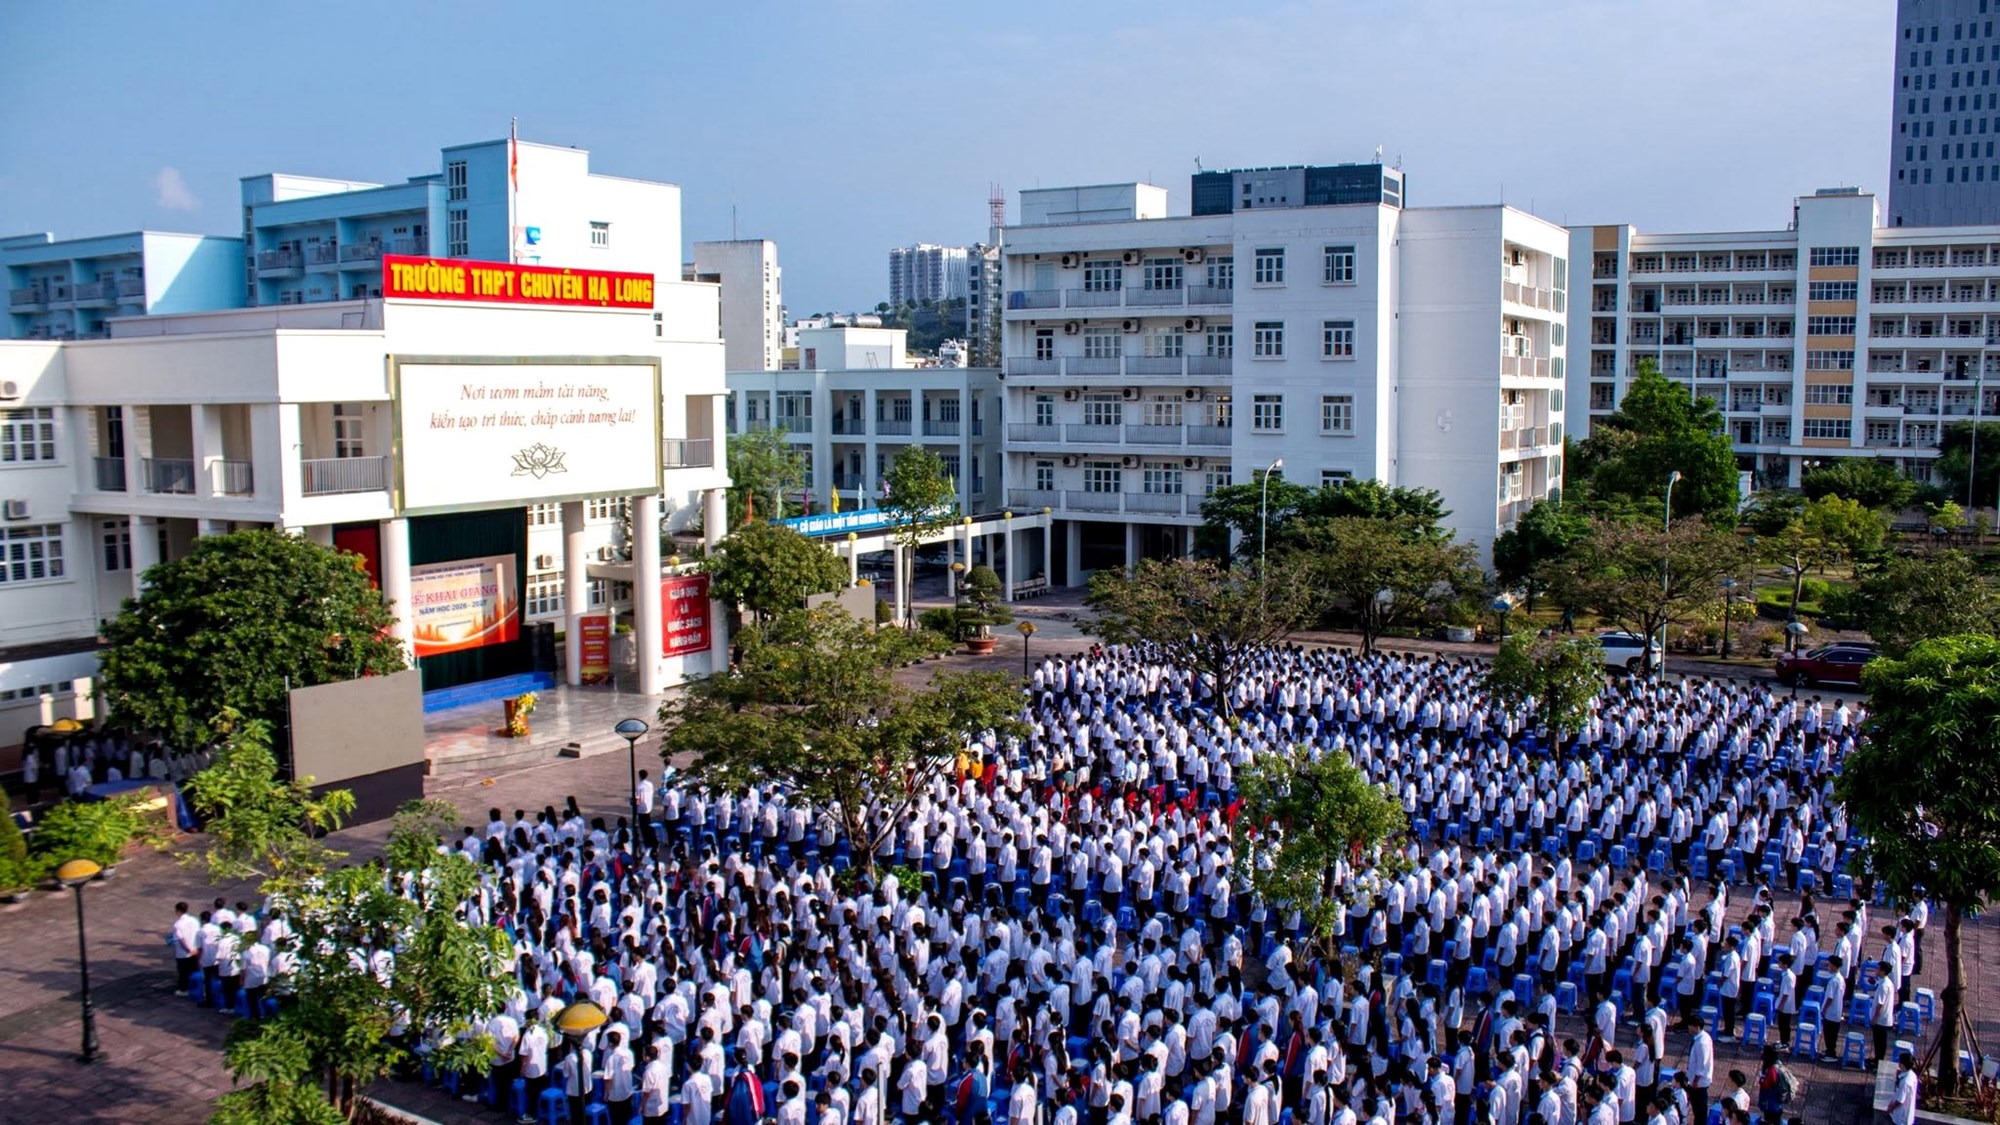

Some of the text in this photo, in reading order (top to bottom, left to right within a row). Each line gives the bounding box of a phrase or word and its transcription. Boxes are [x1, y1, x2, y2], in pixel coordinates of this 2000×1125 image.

[391, 261, 652, 306] TRƯỜNG THPT CHUYÊN HẠ LONG
[460, 381, 610, 402] Nơi ươm mầm tài năng,
[430, 409, 455, 429] kiến
[458, 415, 477, 431] tạo
[500, 410, 527, 428] thức,
[531, 407, 558, 429] chắp
[560, 408, 585, 424] cánh
[588, 411, 616, 427] tương
[618, 407, 636, 424] lai!
[426, 590, 456, 603] KHAI
